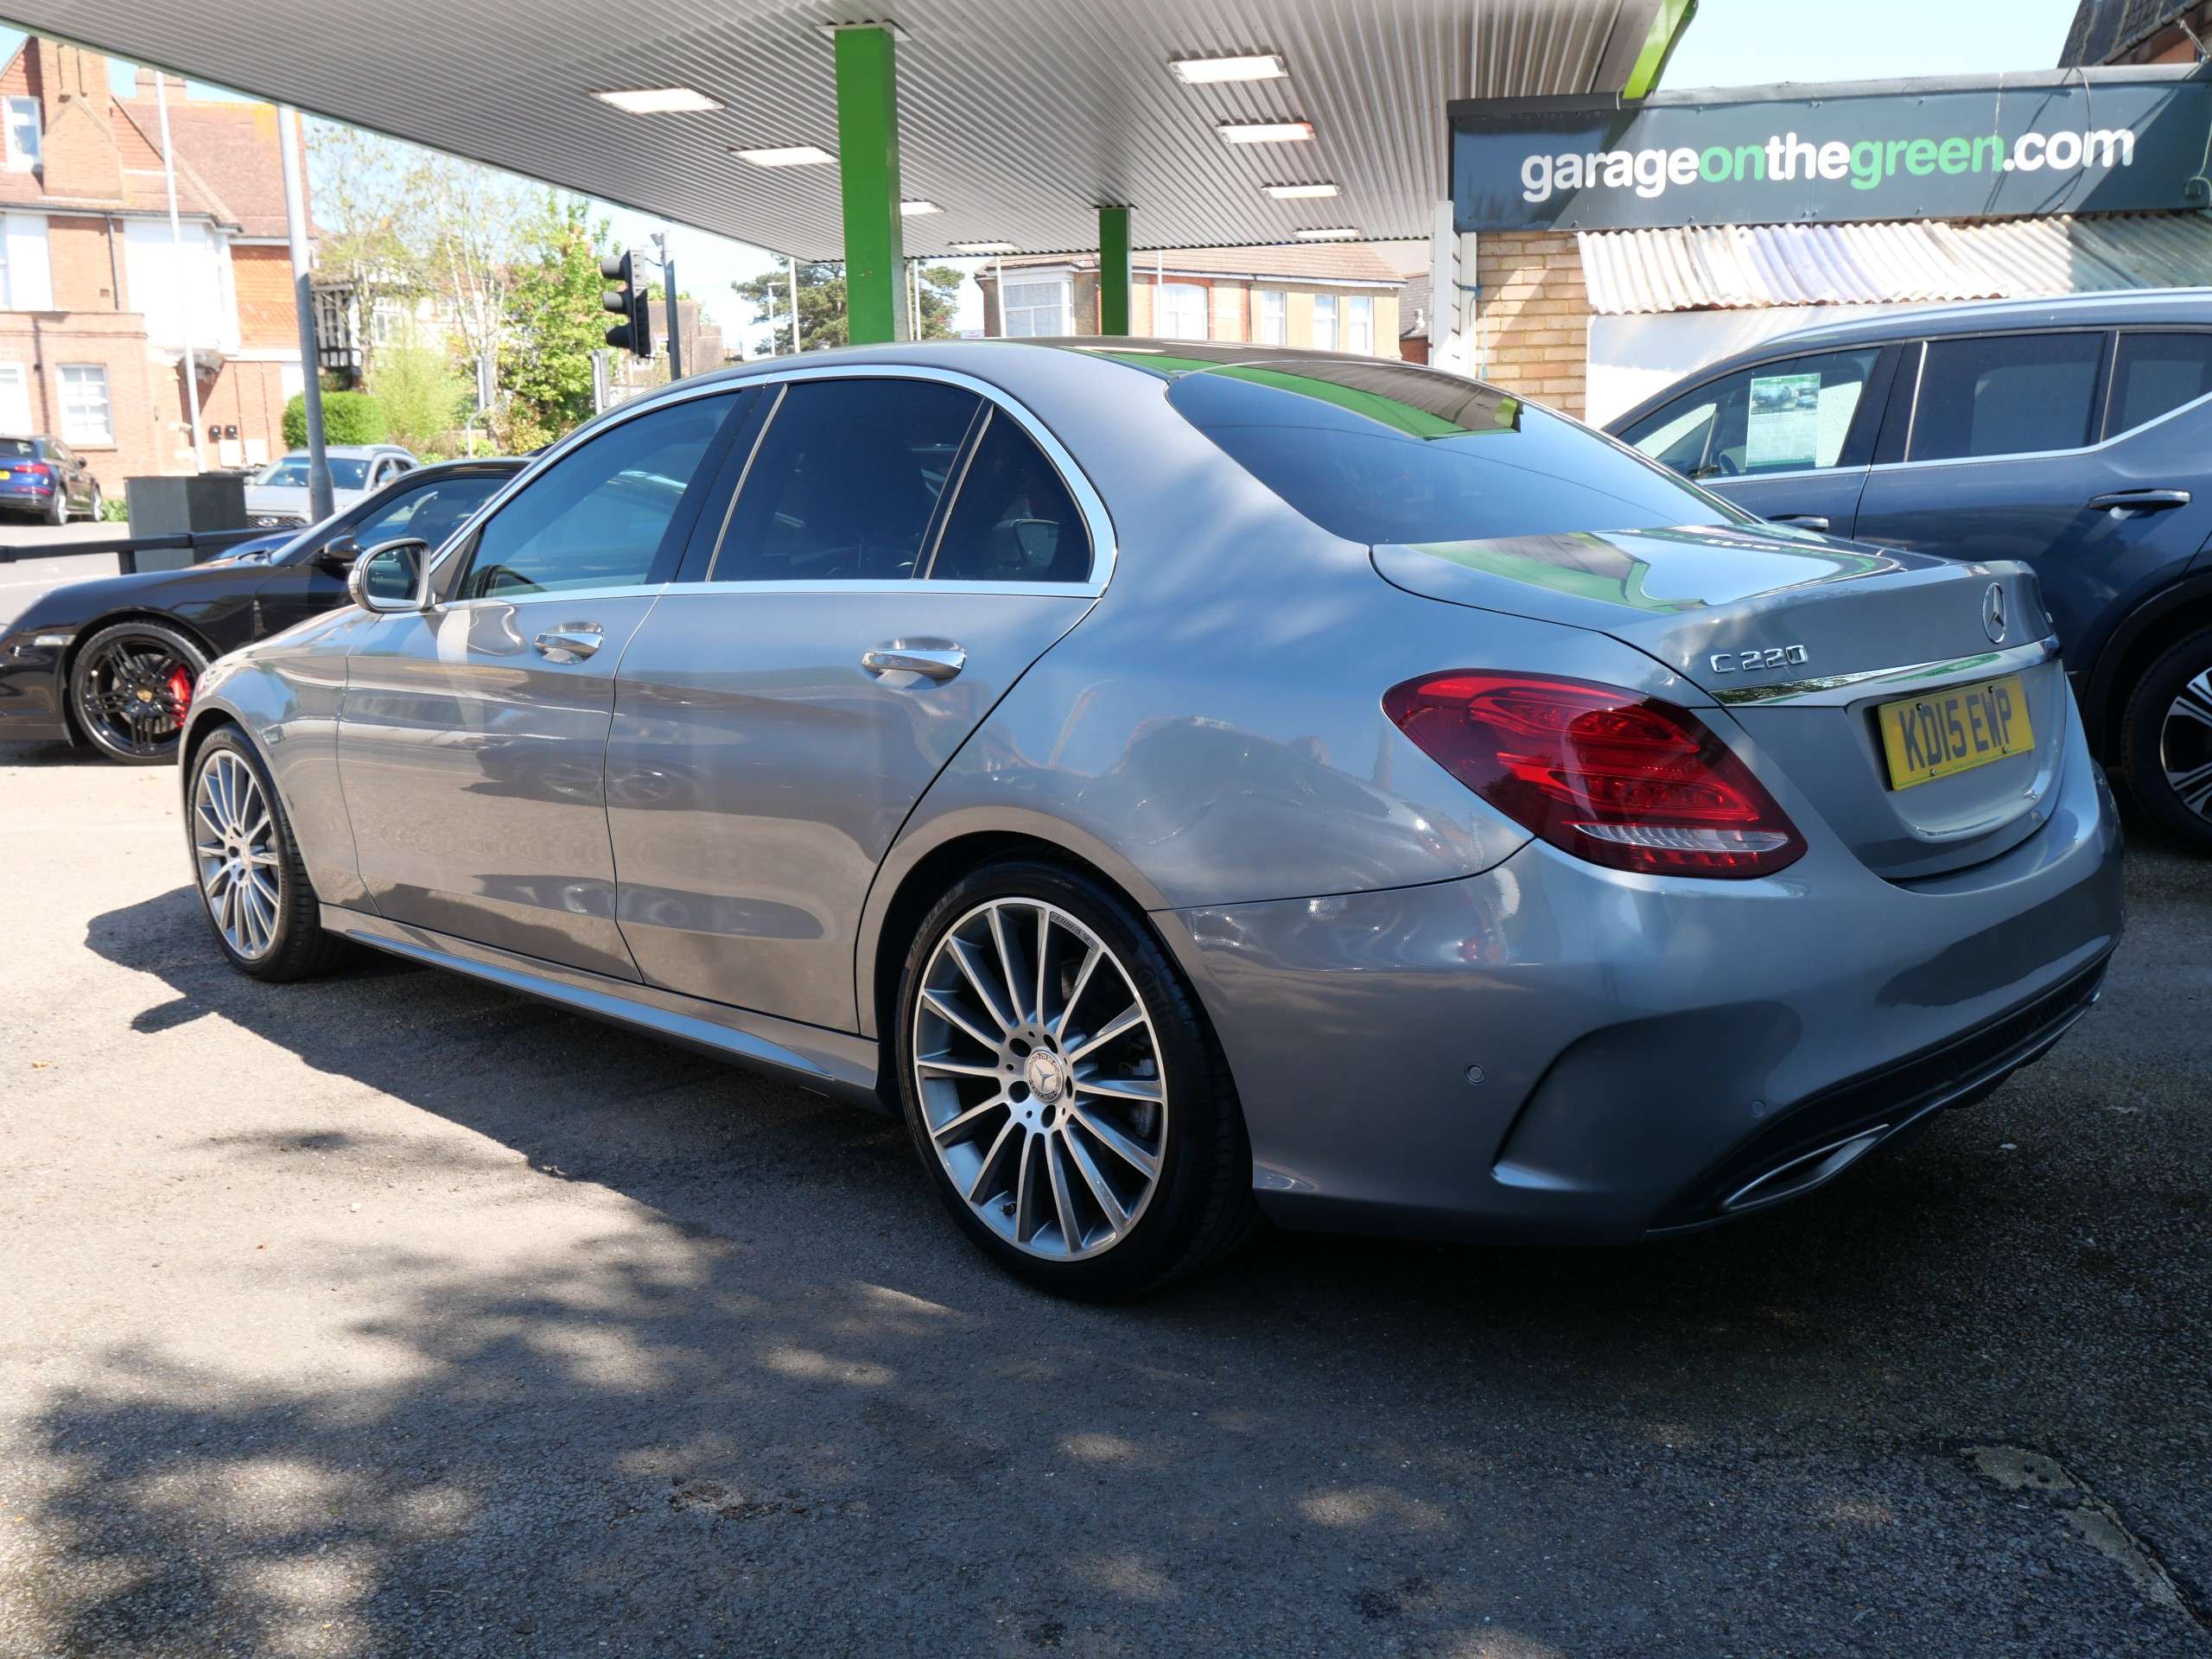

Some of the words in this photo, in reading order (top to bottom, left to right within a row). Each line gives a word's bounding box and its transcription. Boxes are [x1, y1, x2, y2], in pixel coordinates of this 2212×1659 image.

[1521, 127, 2134, 202] garageonthegreen.com
[1710, 653, 1736, 674] C
[1740, 645, 1808, 671] 220
[1898, 699, 1967, 772] KD15
